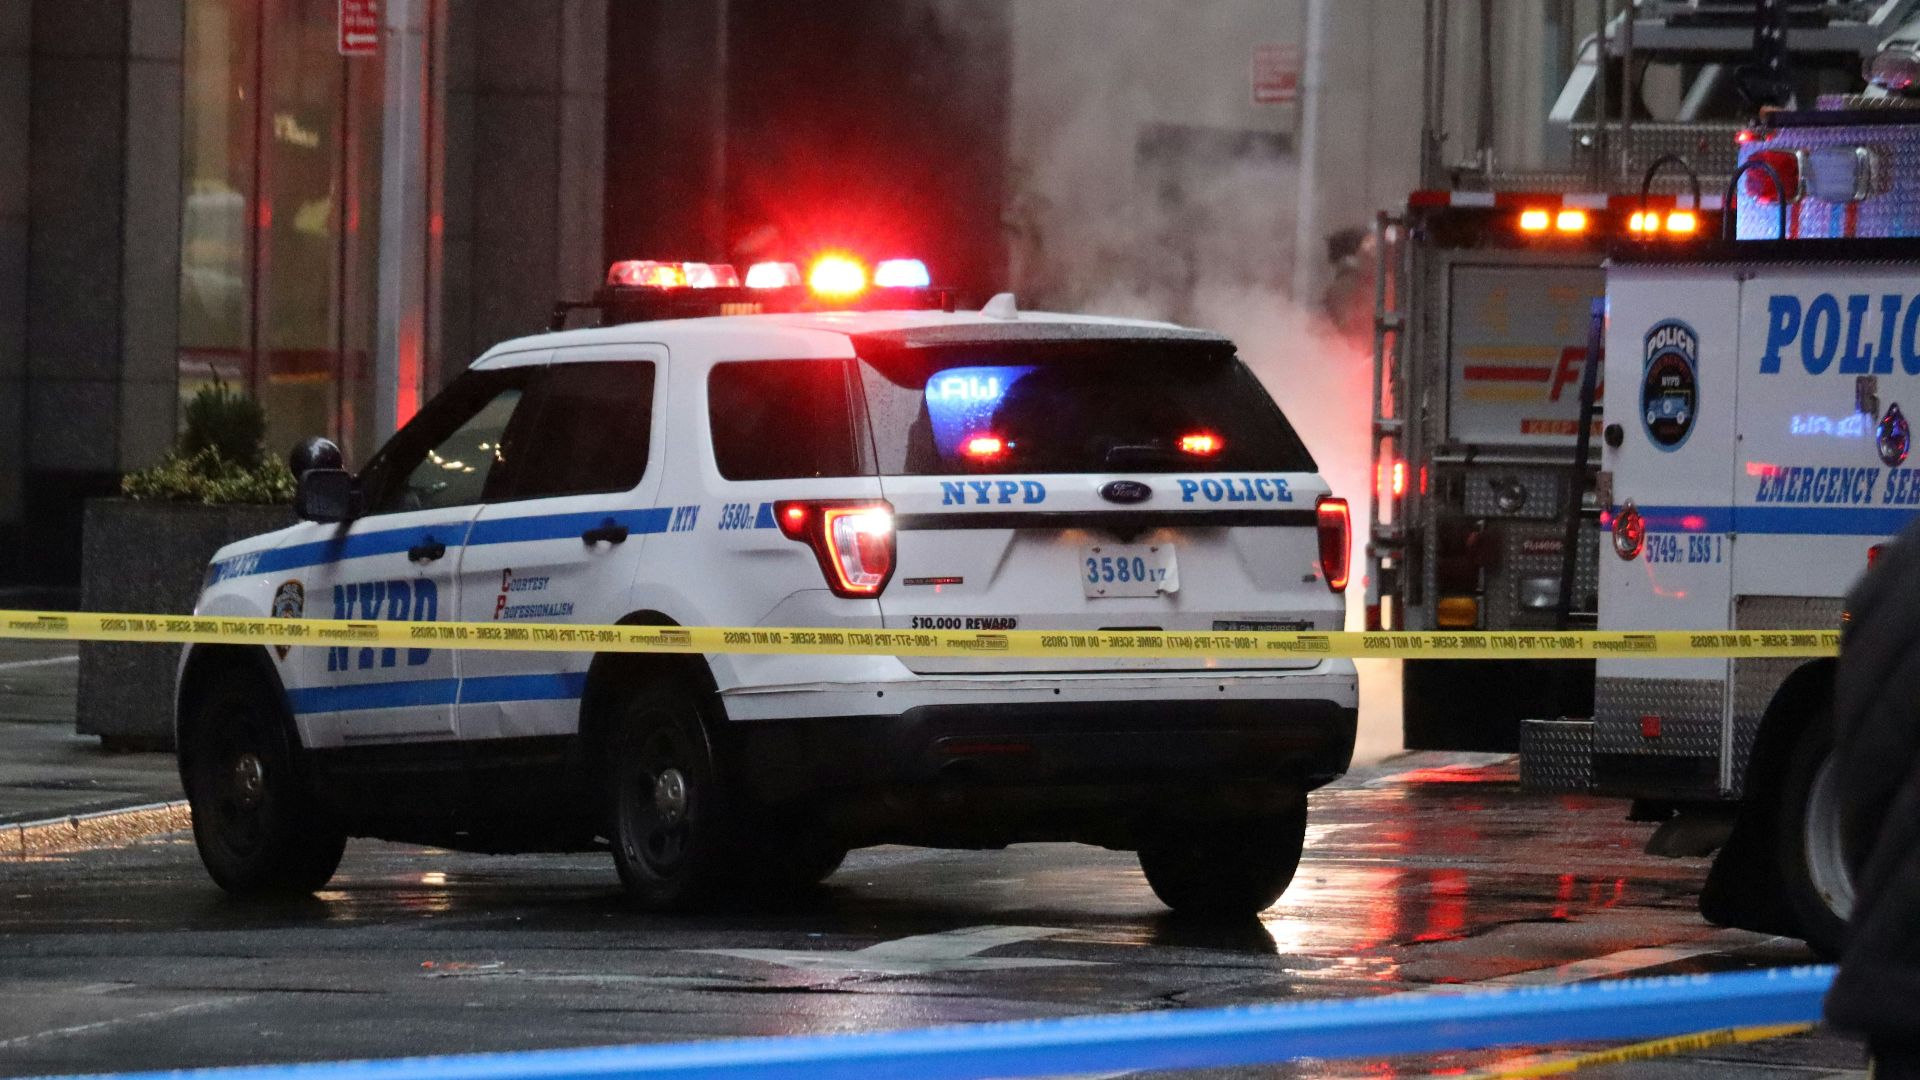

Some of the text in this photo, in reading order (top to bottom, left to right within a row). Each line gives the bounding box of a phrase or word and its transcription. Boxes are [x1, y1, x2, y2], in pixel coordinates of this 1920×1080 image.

[1647, 326, 1695, 361] POLICE
[1661, 376, 1681, 387] NYPD
[940, 480, 1046, 505] NYPD
[1176, 478, 1293, 502] POLICE
[1755, 467, 1880, 504] EMERGENCY
[1688, 535, 1711, 562] ESS
[1086, 556, 1145, 583] 3580
[494, 595, 575, 620] PROFESSIONALISM
[328, 578, 438, 672] NYPD
[965, 617, 1017, 630] REWARD
